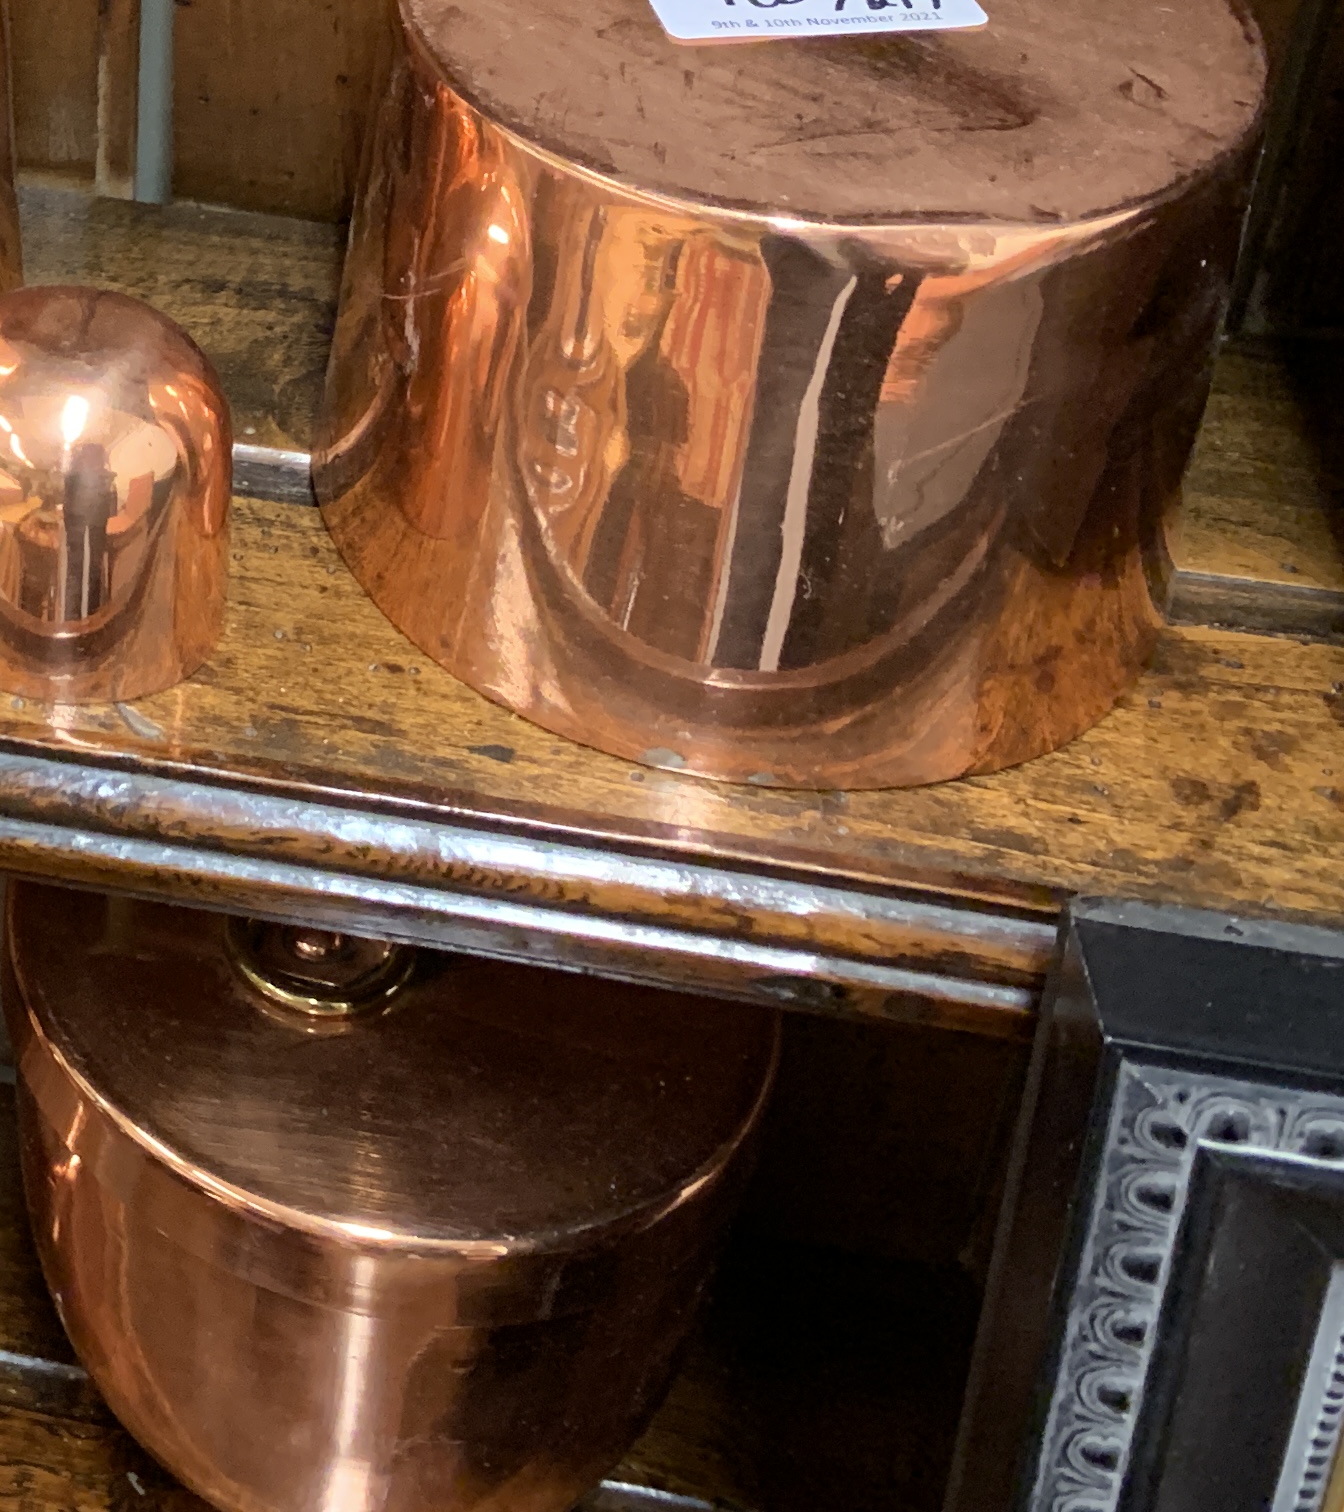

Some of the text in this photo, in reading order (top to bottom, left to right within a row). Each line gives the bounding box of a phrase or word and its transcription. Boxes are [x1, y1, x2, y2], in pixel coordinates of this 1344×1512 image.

[710, 11, 944, 29] 9th & 10th November 2021
